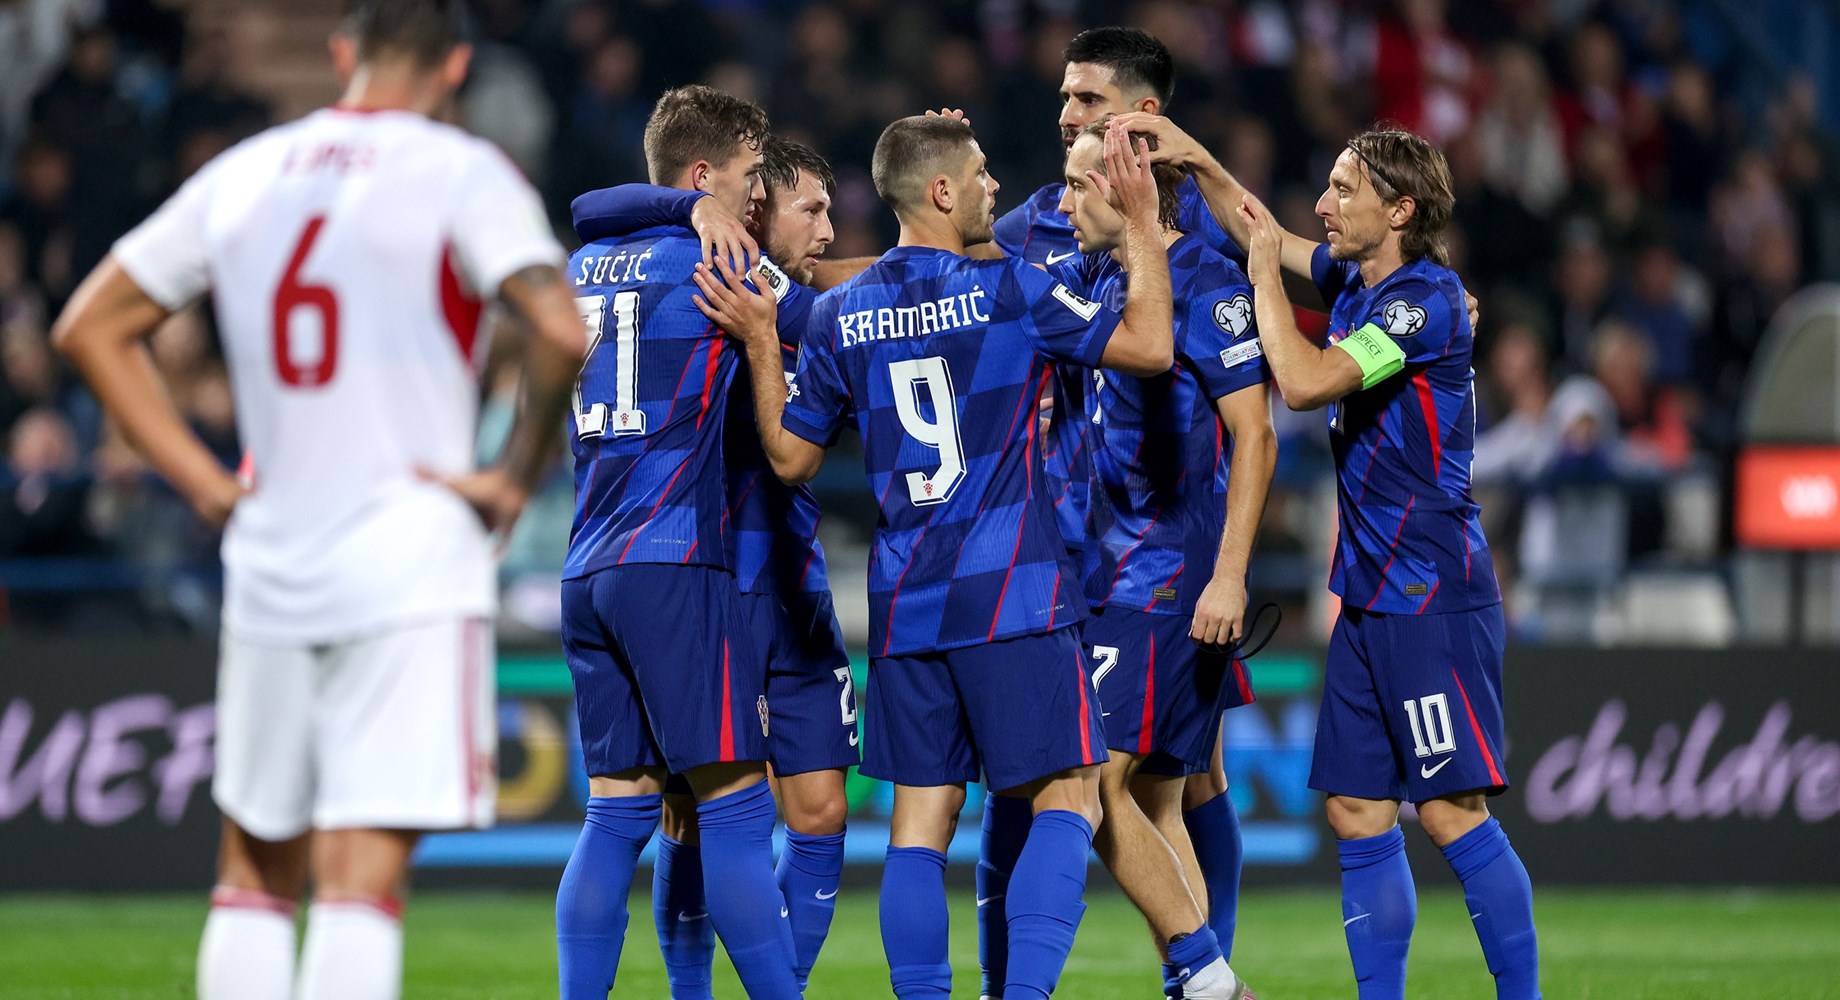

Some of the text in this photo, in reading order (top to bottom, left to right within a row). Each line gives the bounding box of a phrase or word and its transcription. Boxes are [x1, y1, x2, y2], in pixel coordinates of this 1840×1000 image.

[270, 213, 341, 390] 6
[838, 284, 990, 347] KRAMARIĆ
[572, 291, 646, 441] 21
[888, 356, 967, 507] 9
[1091, 645, 1119, 694] 7
[1403, 693, 1456, 758] 10
